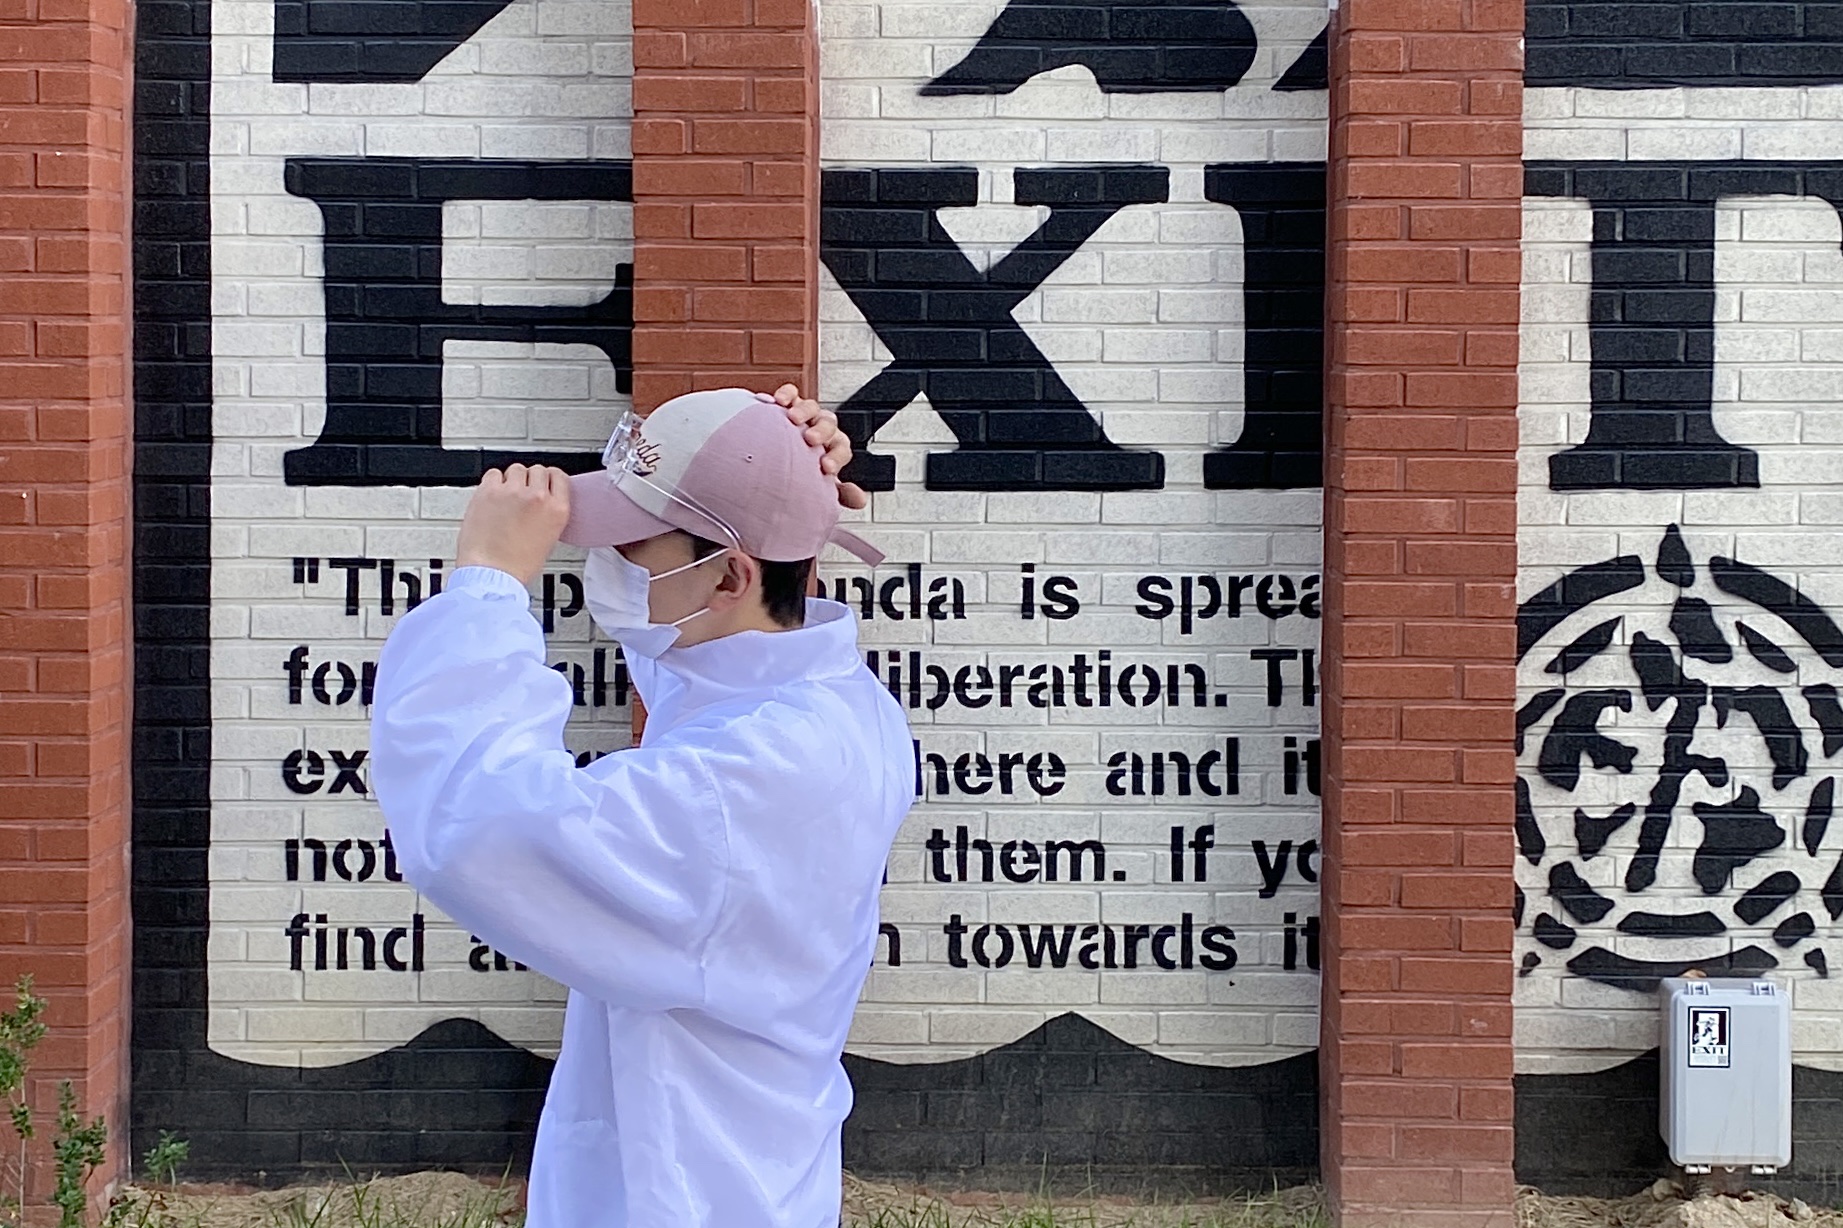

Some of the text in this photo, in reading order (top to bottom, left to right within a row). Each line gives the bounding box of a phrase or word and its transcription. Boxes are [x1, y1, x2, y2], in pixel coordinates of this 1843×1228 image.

[1021, 563, 1079, 619] is
[1106, 738, 1239, 796] and
[926, 826, 1125, 883] them.
[1171, 825, 1214, 881] If
[285, 913, 424, 972] find
[944, 913, 1237, 970] towards
[1692, 1046, 1726, 1054] EXIT
